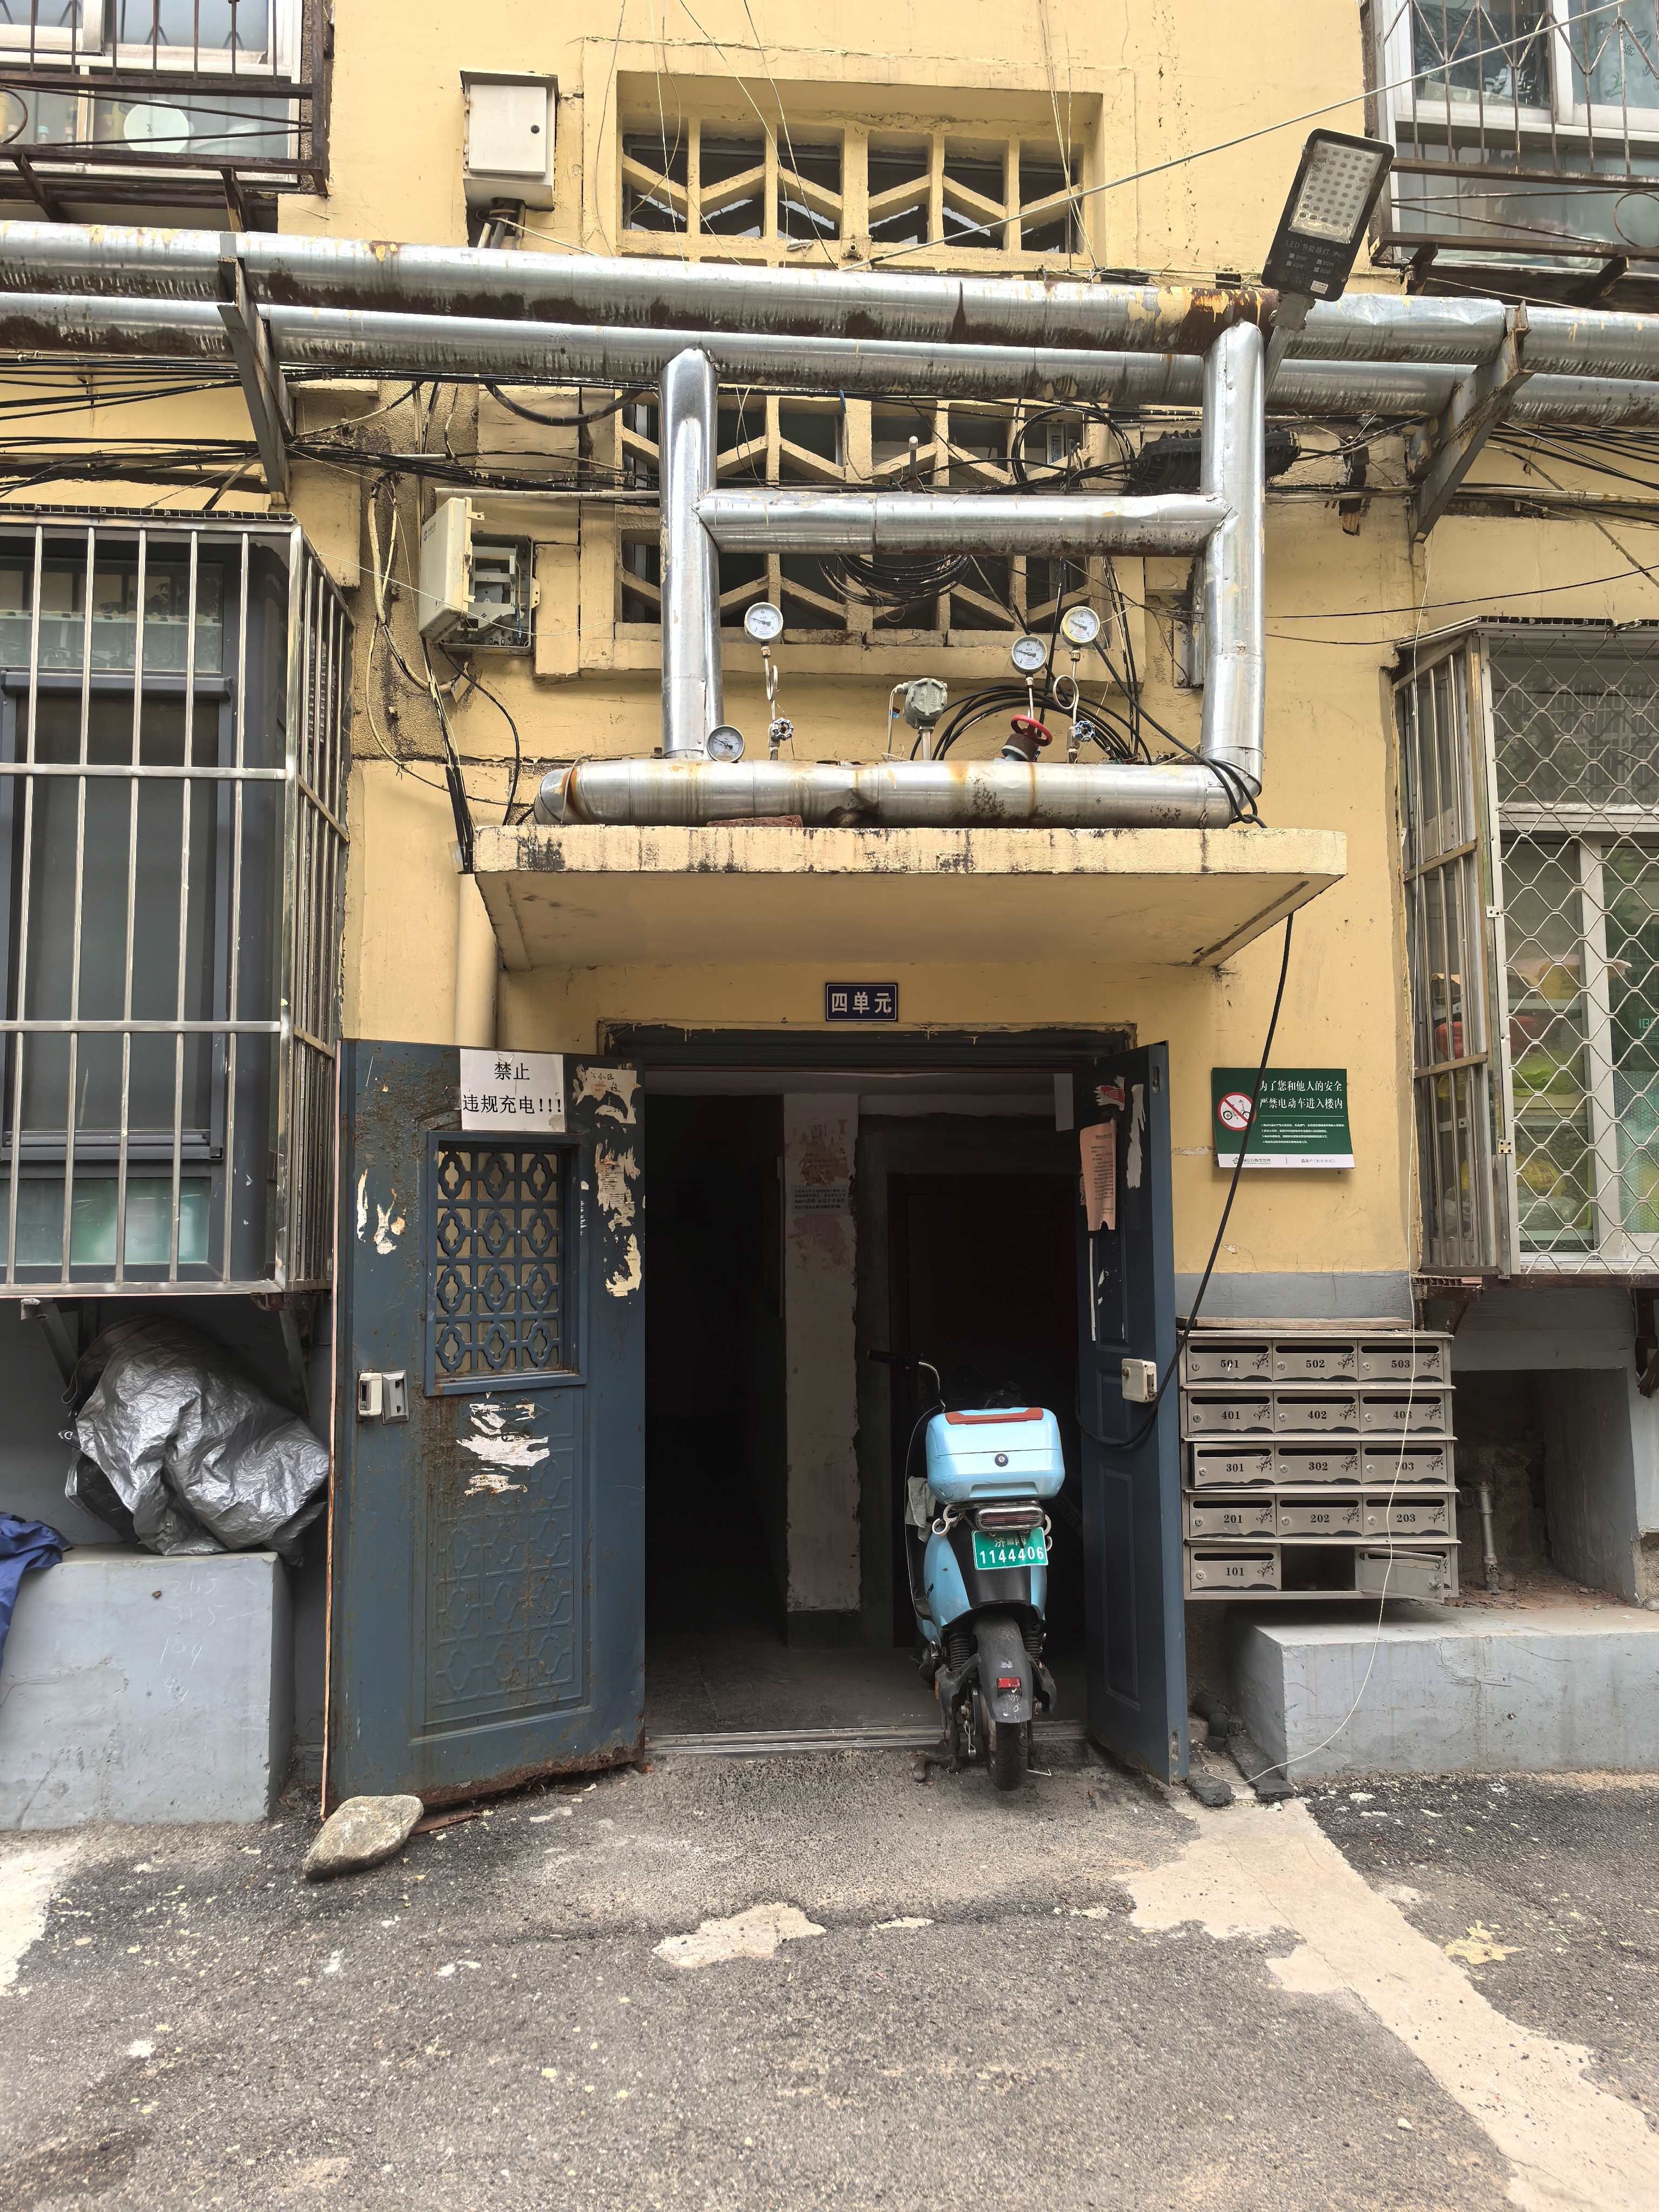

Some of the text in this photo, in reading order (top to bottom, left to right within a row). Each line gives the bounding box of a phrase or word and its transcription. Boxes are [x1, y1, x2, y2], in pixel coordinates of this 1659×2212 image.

[1285, 240, 1300, 248] LED
[832, 992, 892, 1014] 四单元
[494, 1062, 530, 1080] 禁止
[1259, 1080, 1342, 1091] 为了您和他人的安全
[1259, 1097, 1343, 1109] 严禁电动车进入楼内
[1220, 1360, 1239, 1368] 501
[1306, 1360, 1325, 1368] 502
[1391, 1360, 1410, 1368] 503
[1222, 1411, 1240, 1419] 401
[1308, 1411, 1327, 1419] 402
[1393, 1411, 1412, 1419] 403
[1226, 1464, 1244, 1472] 301
[1309, 1462, 1328, 1471] 302
[1395, 1462, 1414, 1470] 303
[1224, 1515, 1243, 1523] 201
[1311, 1514, 1330, 1522] 202
[1397, 1514, 1415, 1522] 203
[980, 1546, 1045, 1564] 1144406
[1226, 1567, 1244, 1576] 101
